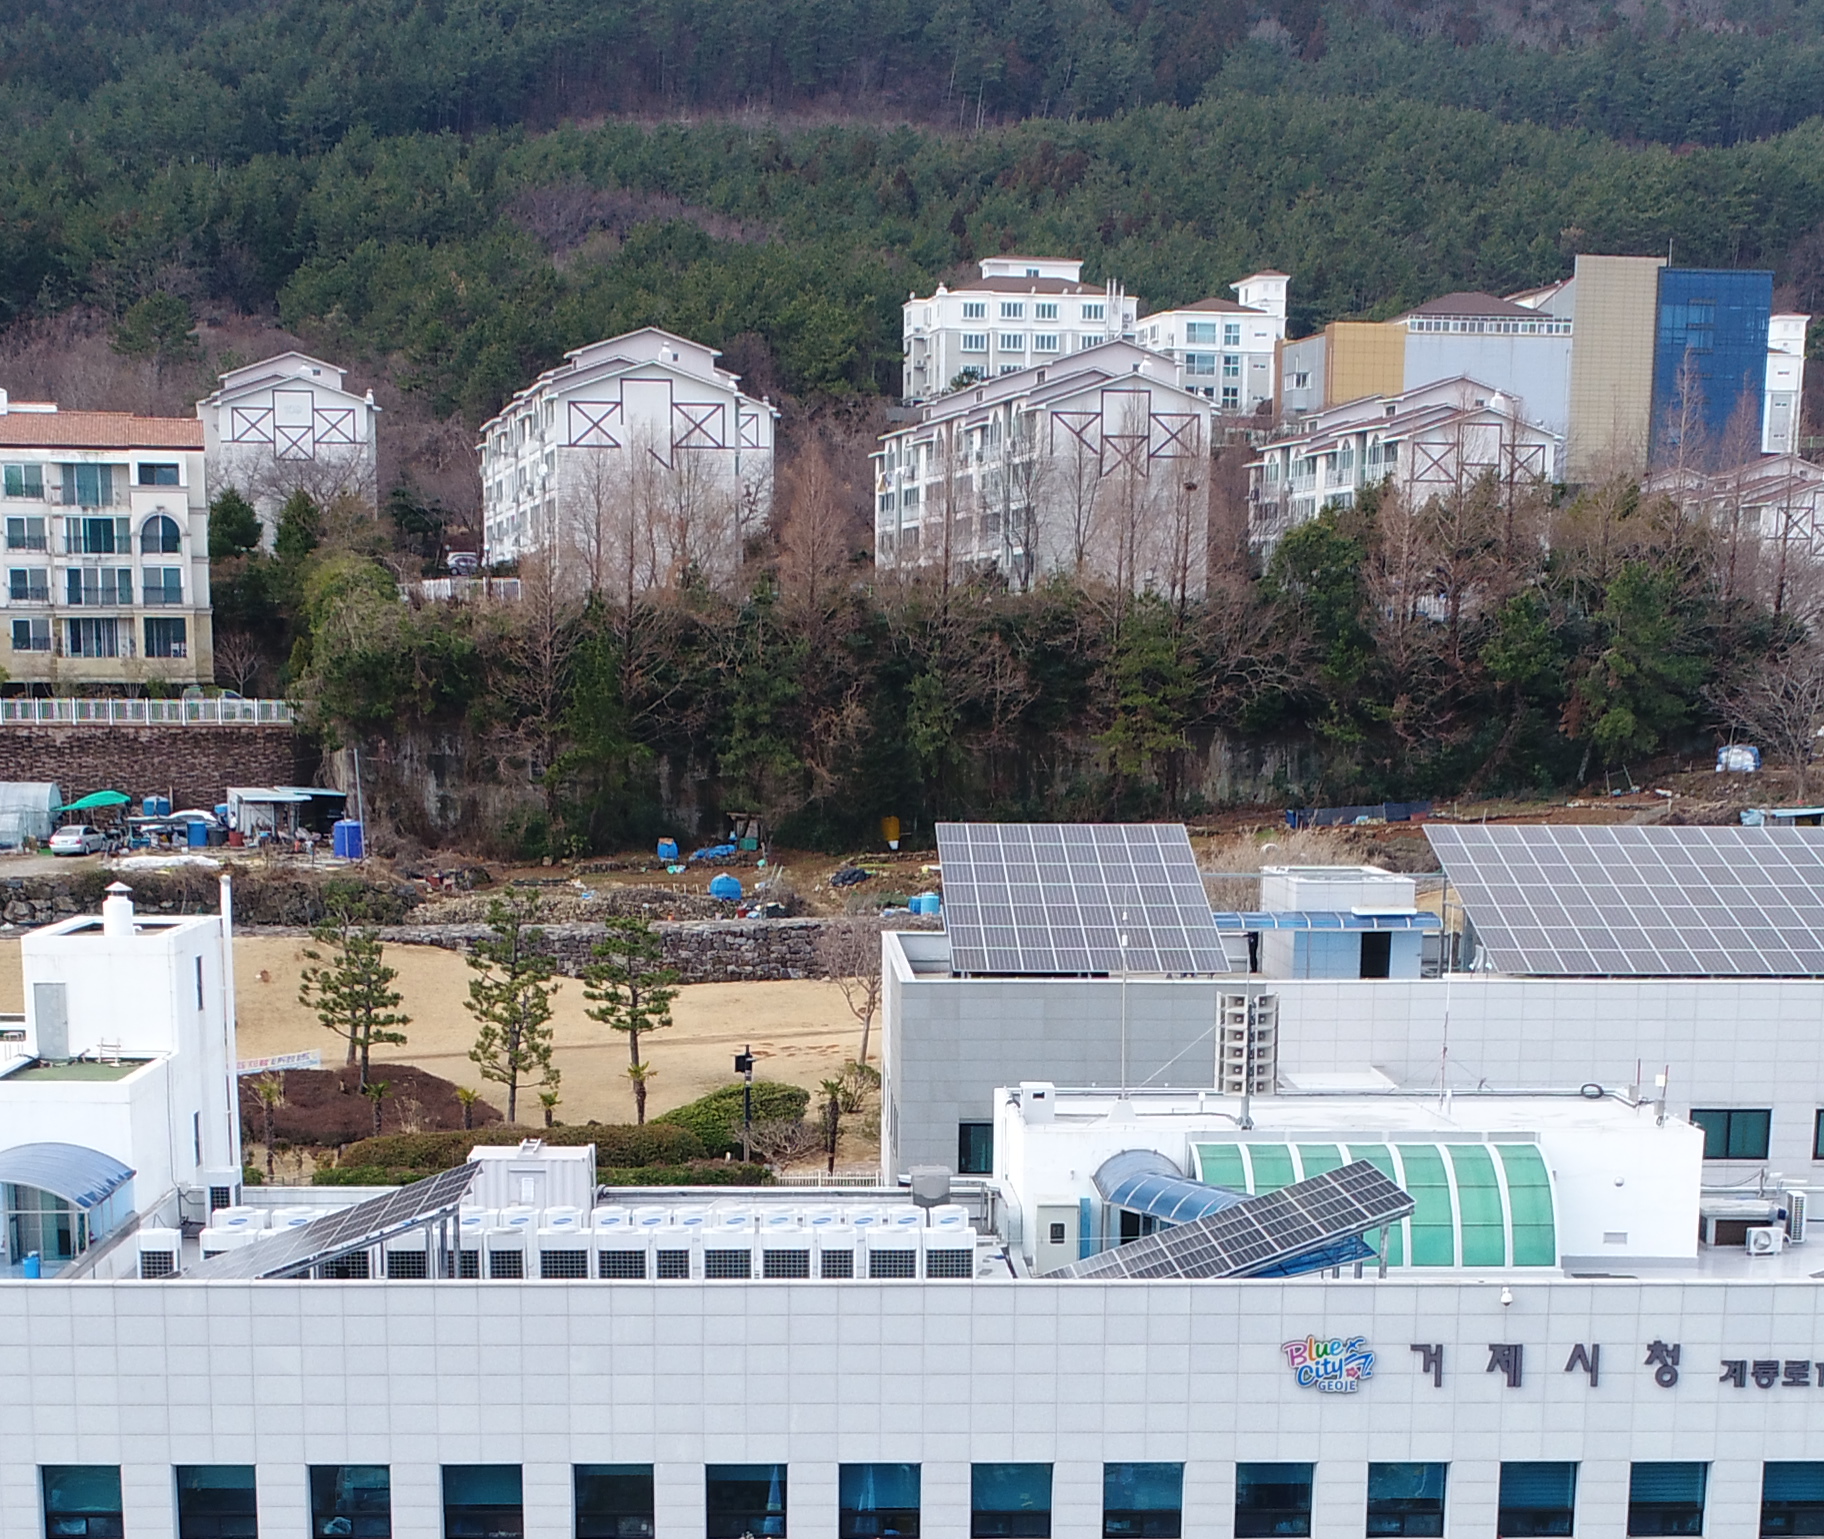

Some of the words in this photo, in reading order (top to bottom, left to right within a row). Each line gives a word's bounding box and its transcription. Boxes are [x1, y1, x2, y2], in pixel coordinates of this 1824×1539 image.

[1281, 1336, 1343, 1367] Blue
[1297, 1358, 1345, 1386] City
[1317, 1380, 1357, 1391] GEOJE
